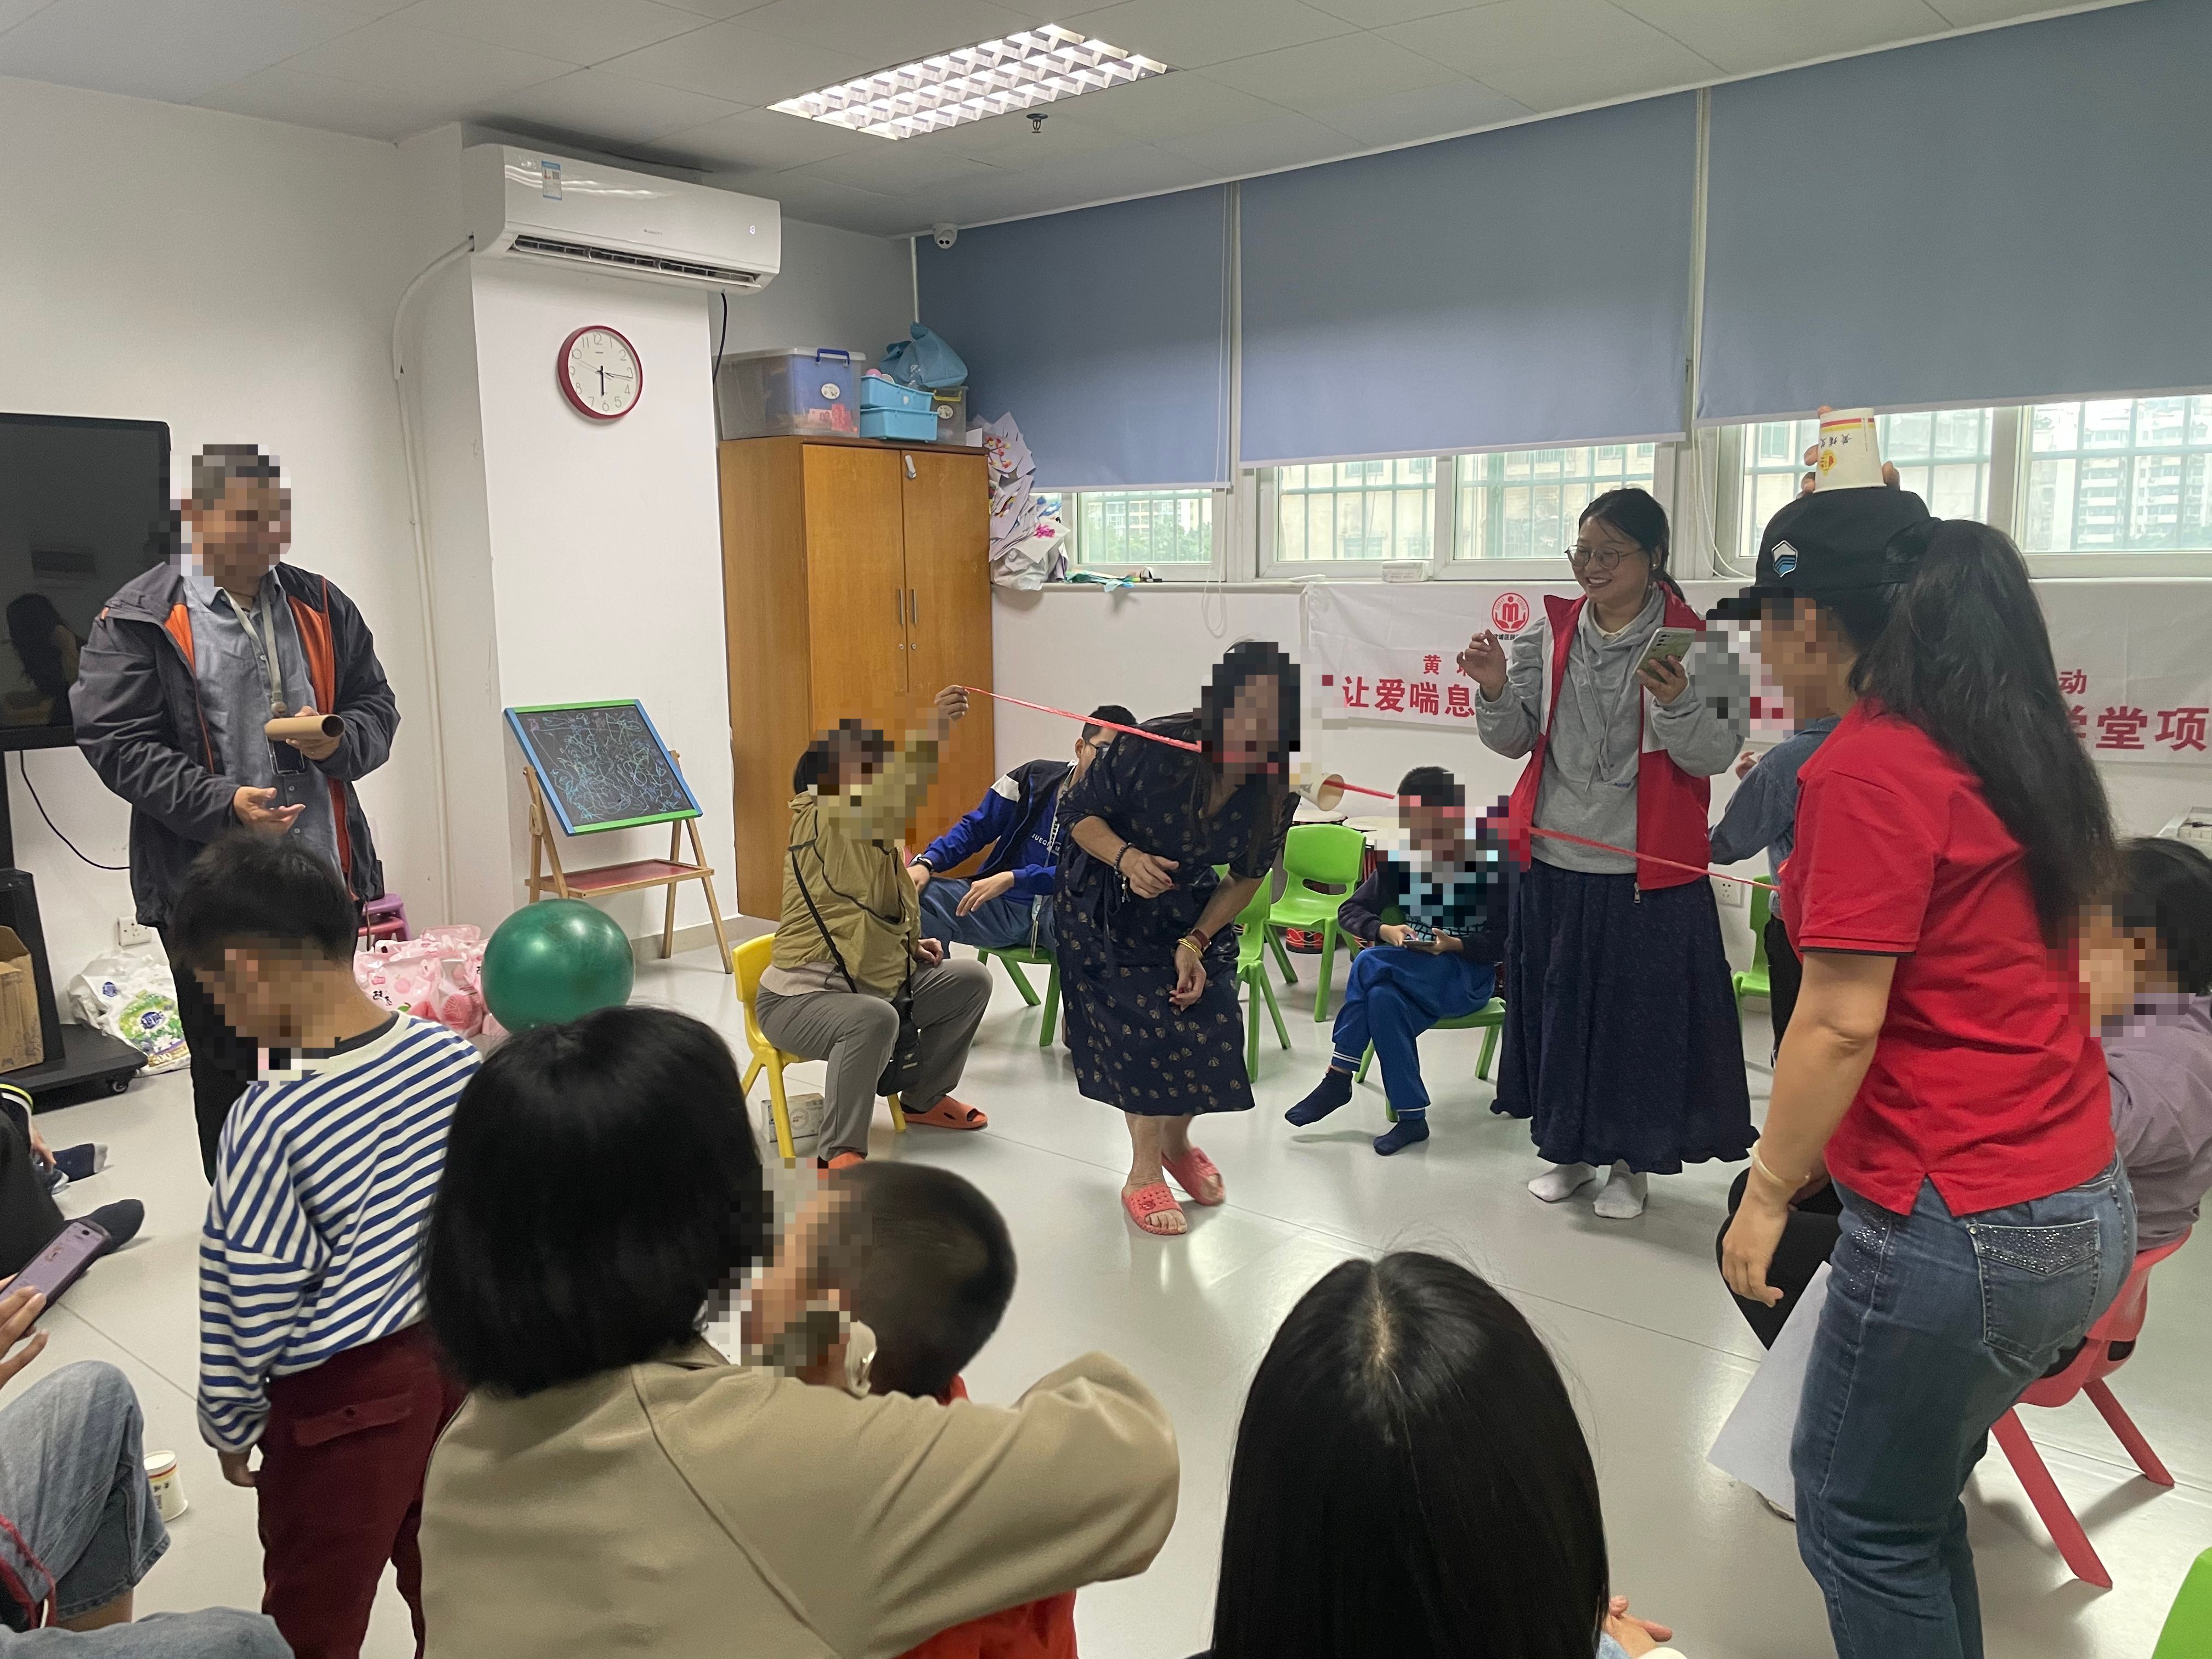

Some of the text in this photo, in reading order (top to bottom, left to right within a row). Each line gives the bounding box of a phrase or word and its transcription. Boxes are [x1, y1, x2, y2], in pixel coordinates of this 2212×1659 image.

[582, 336, 589, 348] 11
[593, 332, 602, 345] 12
[619, 349, 627, 361] 2
[568, 366, 575, 378] 9
[627, 366, 634, 379] 3
[576, 382, 582, 395] 8
[624, 384, 631, 395] 4
[588, 396, 595, 408] 7
[602, 400, 610, 411] 6
[614, 396, 622, 408] 5
[2058, 668, 2087, 695] 动
[1342, 675, 1476, 718] 让爱喘息
